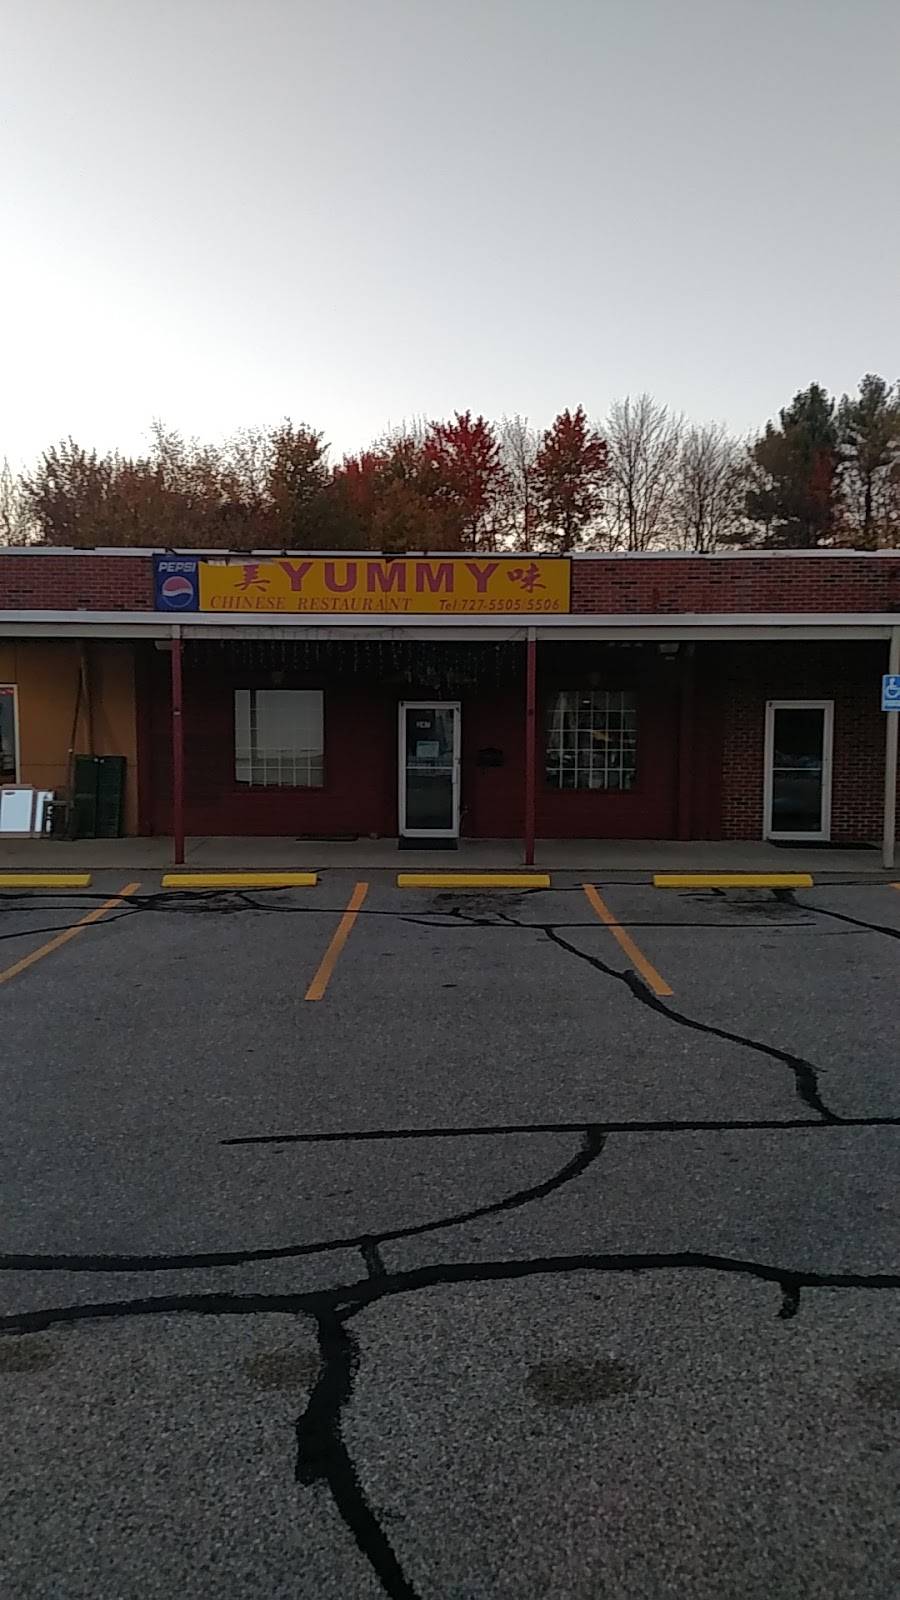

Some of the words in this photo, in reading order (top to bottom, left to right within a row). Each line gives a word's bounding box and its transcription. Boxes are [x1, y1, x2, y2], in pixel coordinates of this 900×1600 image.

[158, 561, 197, 572] PEPSI
[234, 564, 270, 592] 美
[278, 561, 499, 593] YUMMY
[506, 562, 546, 593] 味
[210, 596, 286, 609] CHINESE
[297, 597, 412, 611] RESTAURANT
